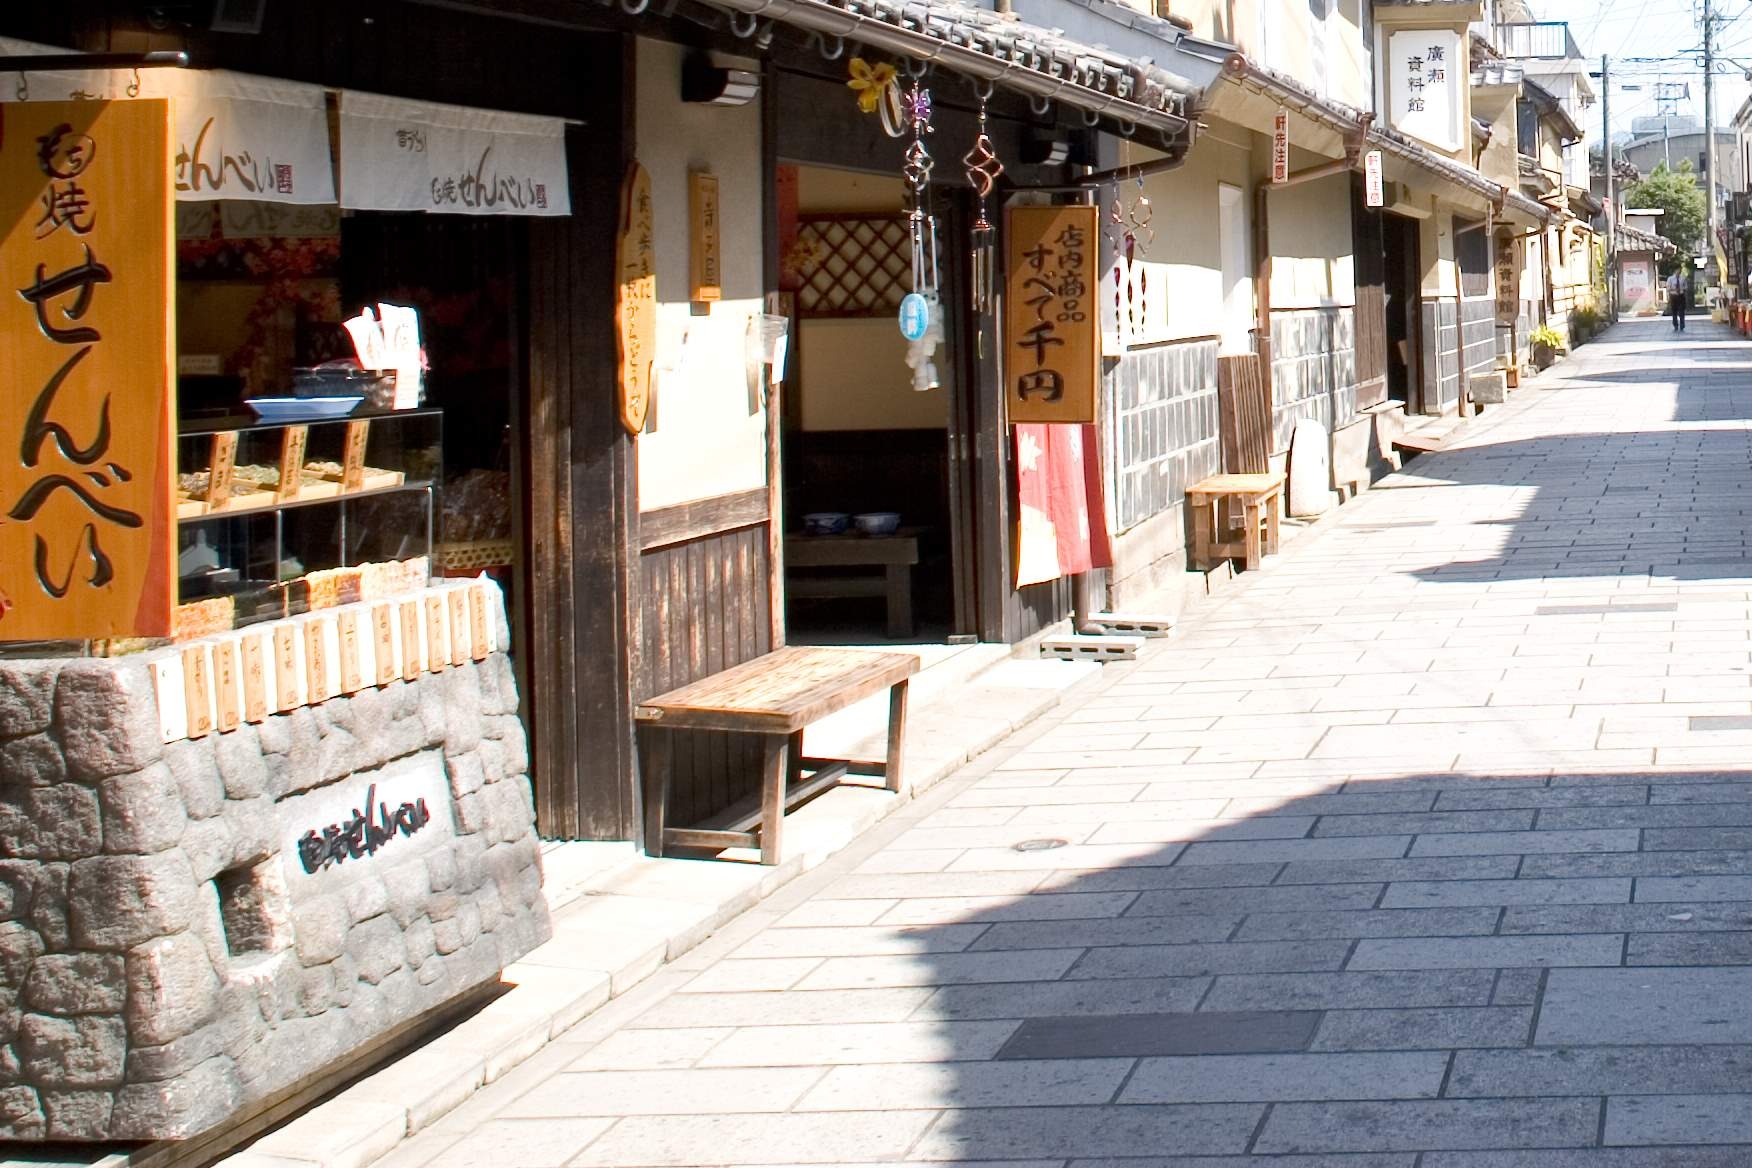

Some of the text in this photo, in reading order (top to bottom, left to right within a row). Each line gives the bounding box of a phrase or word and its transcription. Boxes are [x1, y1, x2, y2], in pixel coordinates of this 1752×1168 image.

[1407, 55, 1426, 114] 資料館
[1016, 243, 1065, 403] すべて千円
[1054, 223, 1087, 323] 店内商品
